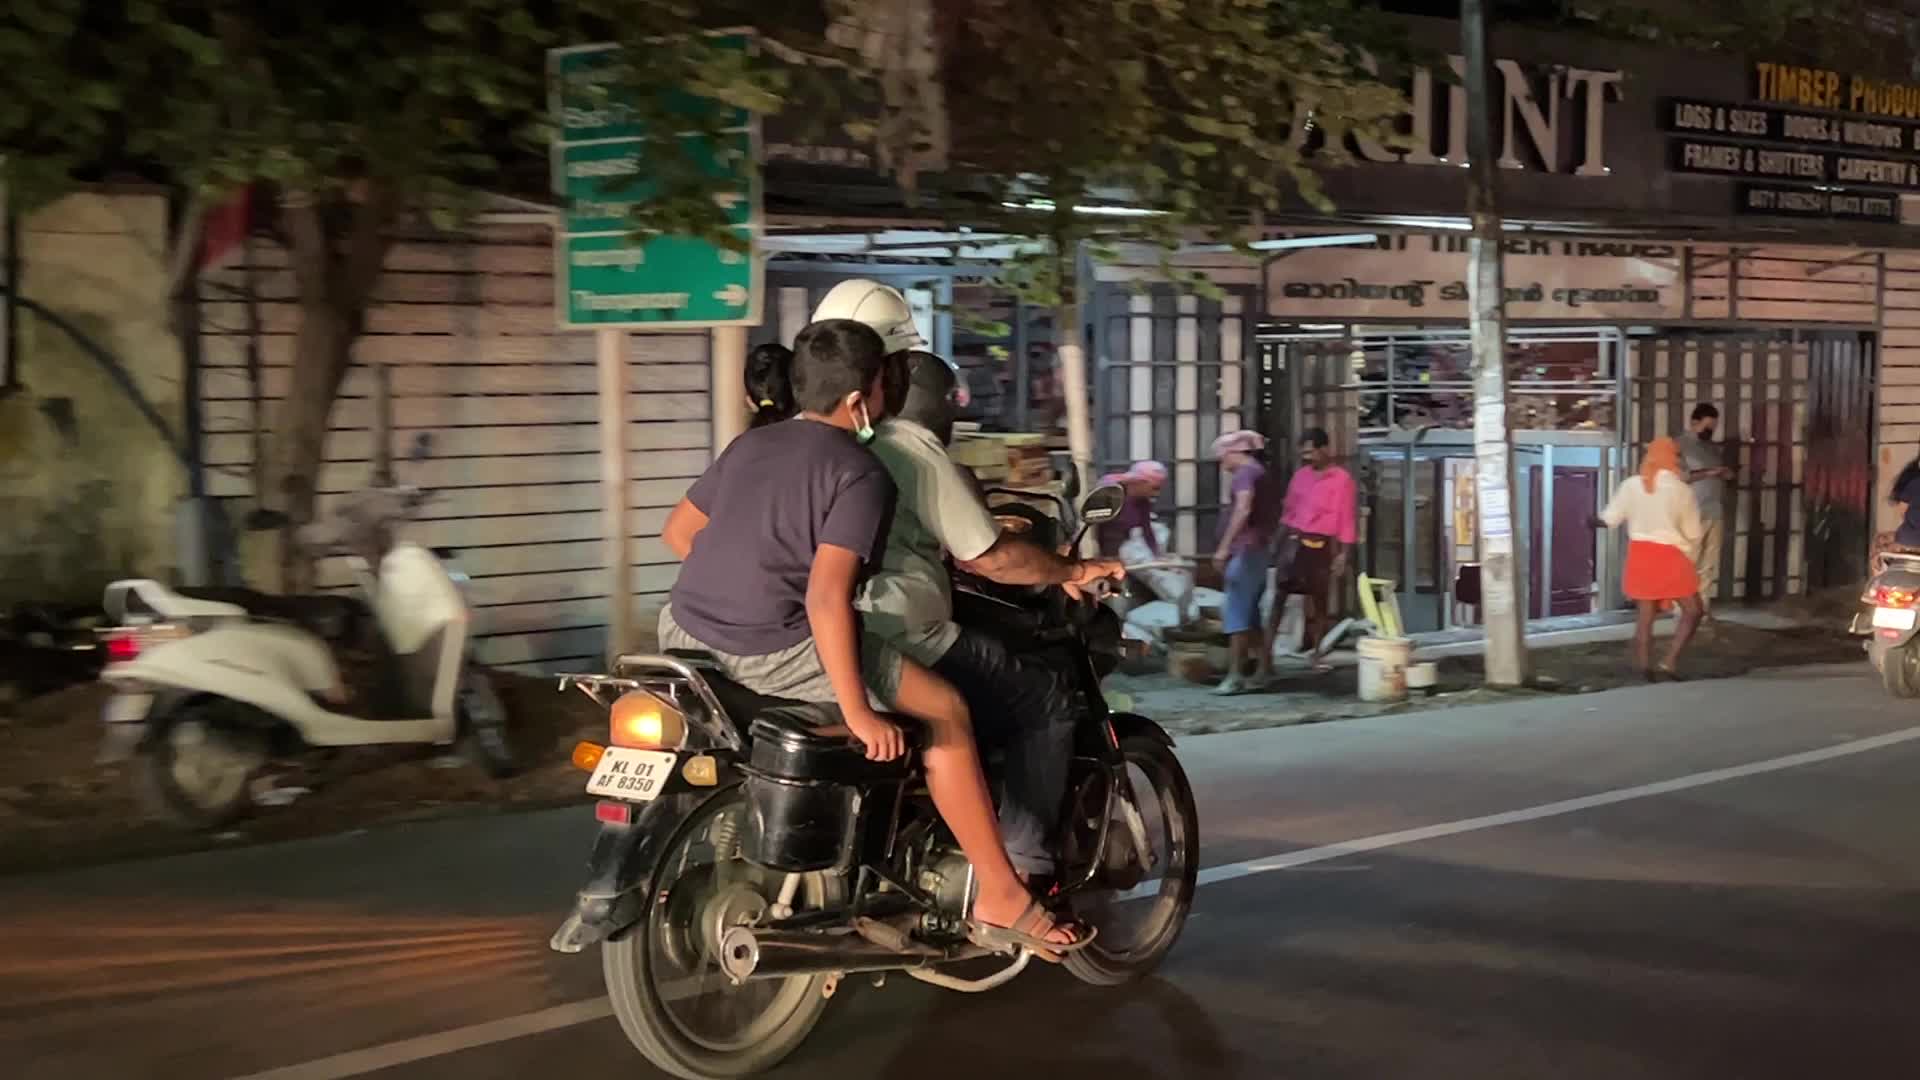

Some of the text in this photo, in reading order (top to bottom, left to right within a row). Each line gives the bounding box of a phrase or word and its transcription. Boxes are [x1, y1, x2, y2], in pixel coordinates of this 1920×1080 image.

[1757, 62, 1920, 118] TIMBER PRODU
[1675, 103, 1712, 130] LOGS
[1729, 108, 1768, 135] SIZES
[1684, 143, 1741, 171] FRAMES
[1758, 151, 1825, 177] SHUTTERS
[1838, 157, 1907, 184] CARPENTRY
[597, 774, 655, 792] AF 8350
[611, 760, 655, 777] KL 01
